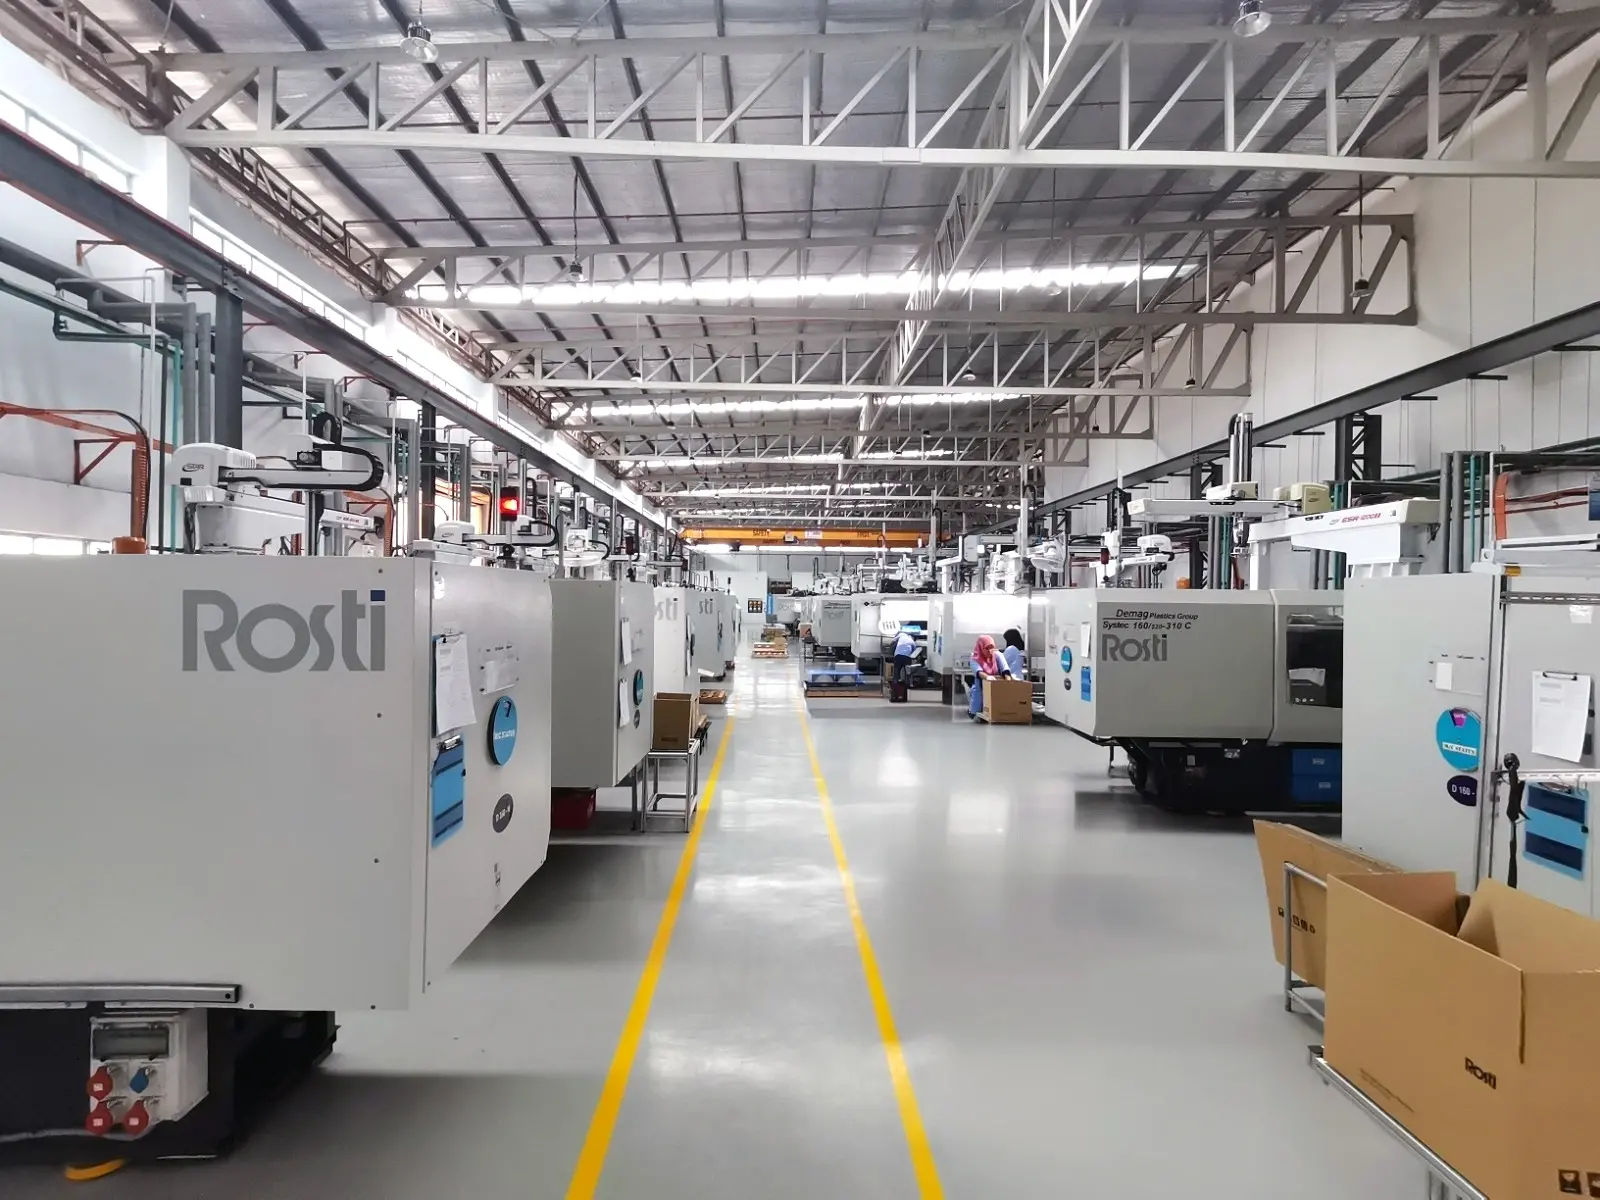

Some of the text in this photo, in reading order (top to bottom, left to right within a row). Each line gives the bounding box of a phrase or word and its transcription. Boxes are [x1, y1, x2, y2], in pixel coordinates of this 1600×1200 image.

[1116, 609, 1149, 620] Demag
[182, 589, 386, 673] Rosti
[1102, 621, 1129, 630] Systec
[1102, 634, 1167, 661] Rosti
[1451, 783, 1458, 793] D
[1465, 1056, 1496, 1090] Rosti
